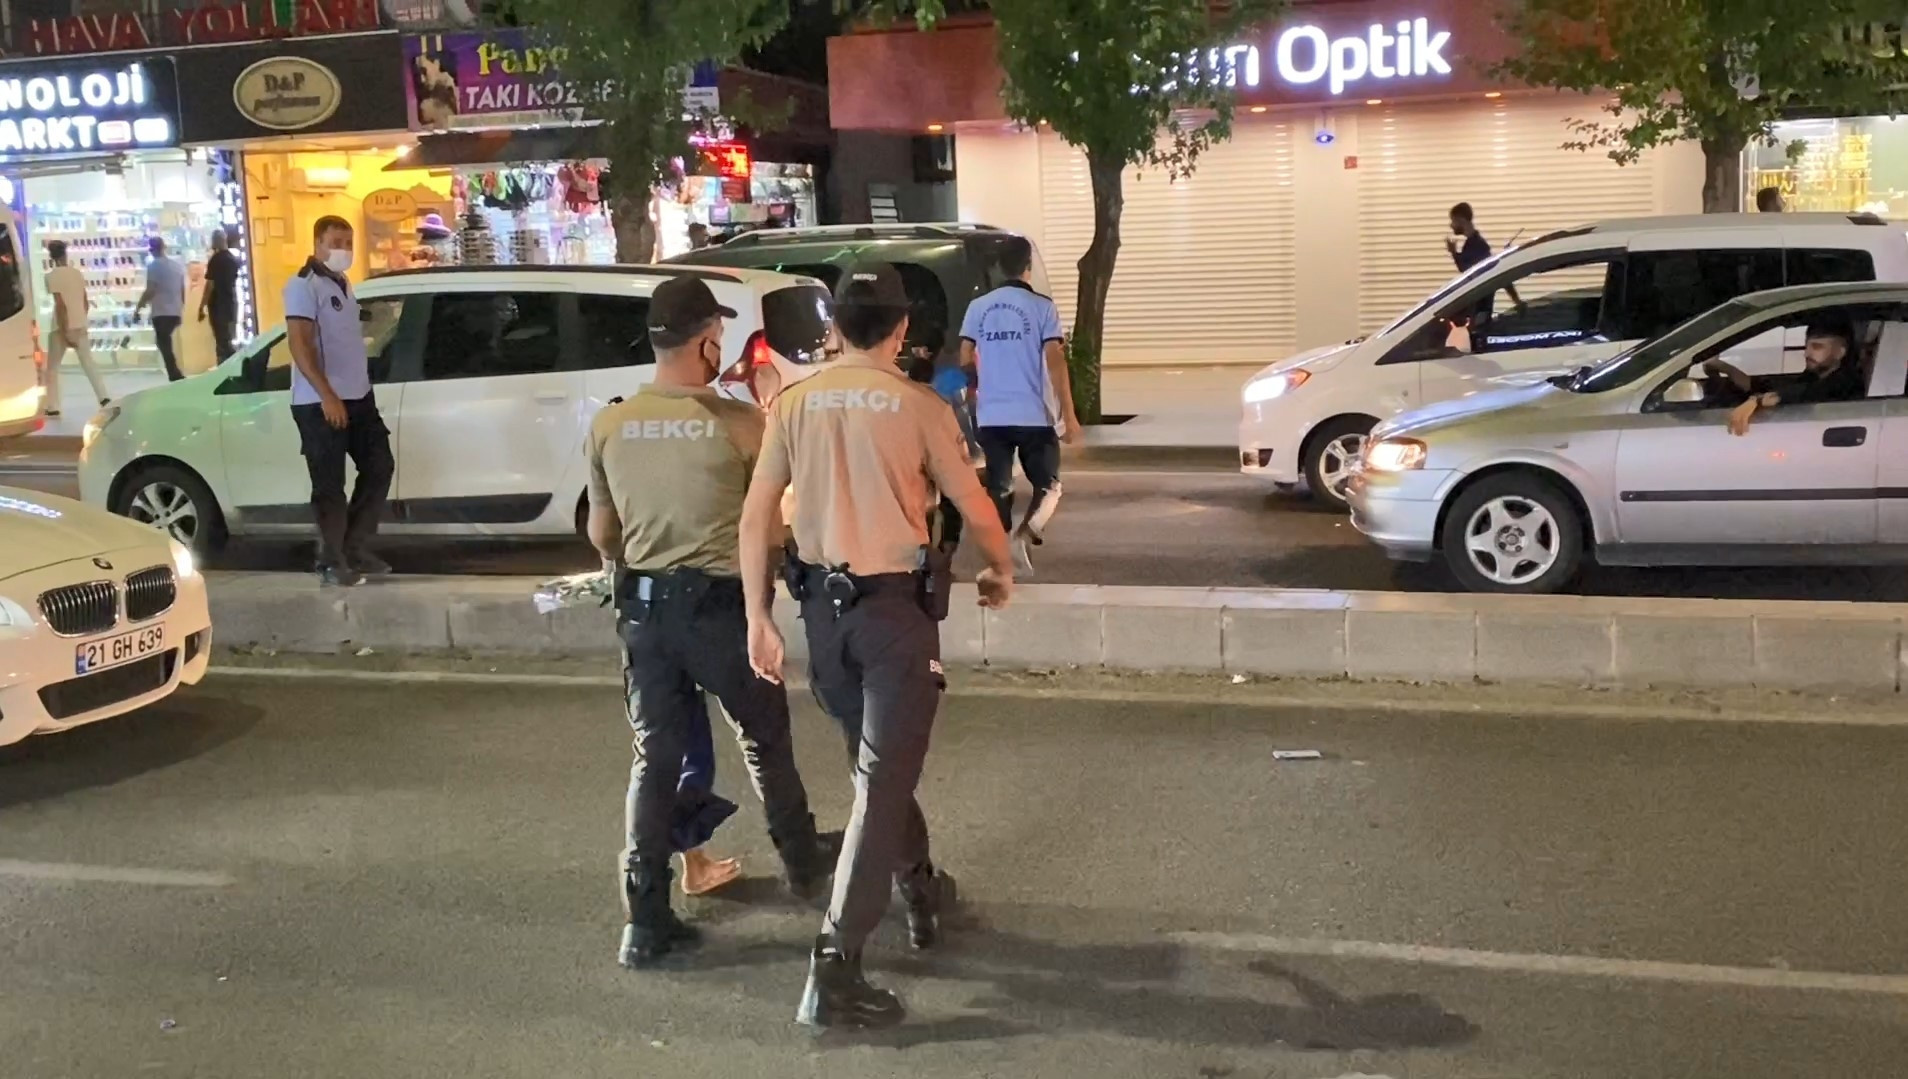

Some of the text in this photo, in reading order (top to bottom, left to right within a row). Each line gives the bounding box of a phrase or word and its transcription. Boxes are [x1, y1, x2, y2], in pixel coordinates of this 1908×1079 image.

[1276, 17, 1452, 95] Optik
[466, 83, 520, 109] TAKI
[87, 627, 163, 668] 21 GH 639
